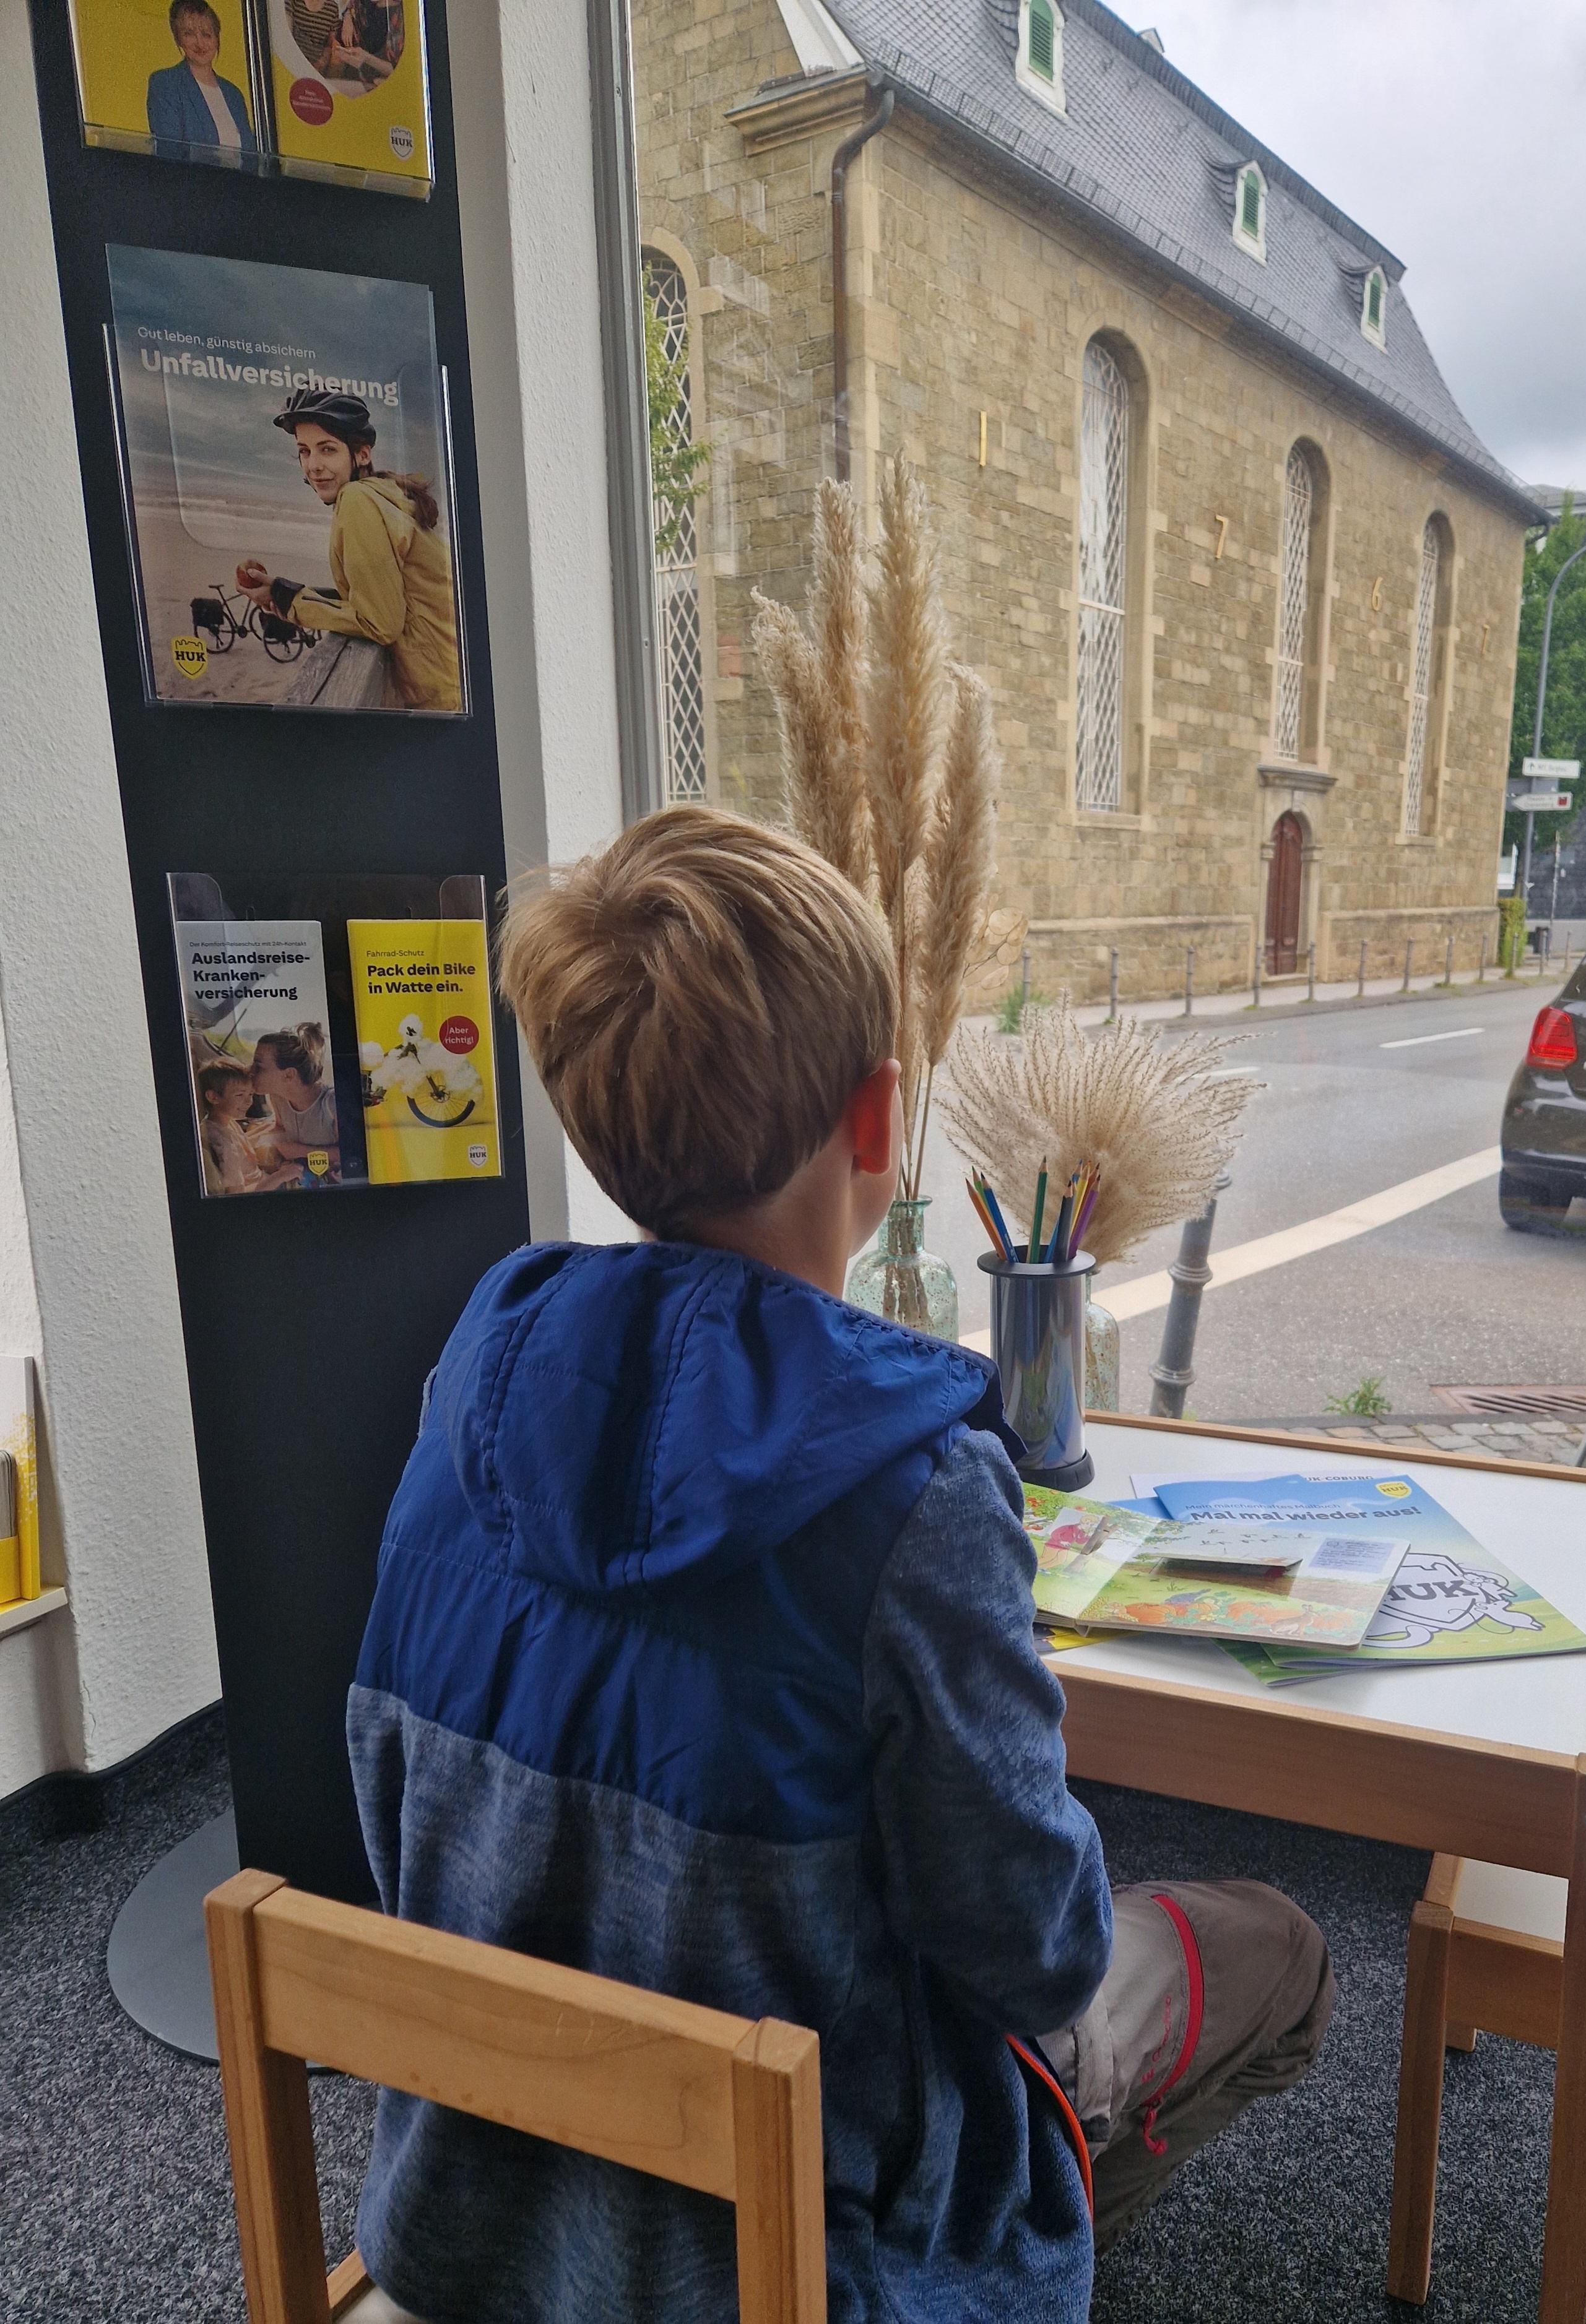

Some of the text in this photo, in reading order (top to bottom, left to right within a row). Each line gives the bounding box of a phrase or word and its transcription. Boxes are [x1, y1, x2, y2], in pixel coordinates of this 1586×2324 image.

[391, 136, 412, 147] HUK
[137, 326, 316, 359] Gut leben, günstig absichern
[140, 348, 399, 407] Unfallversicherung
[175, 650, 206, 662] HUK
[192, 951, 310, 964] Auslandsreise-
[193, 969, 265, 982] Kranken-
[367, 963, 476, 977] Pack dein Bike
[195, 987, 298, 1000] versicherung
[368, 980, 464, 994] in Watte ein.
[445, 1036, 474, 1045] richtig!
[1190, 1506, 1422, 1521] Mal mal wieder aus!
